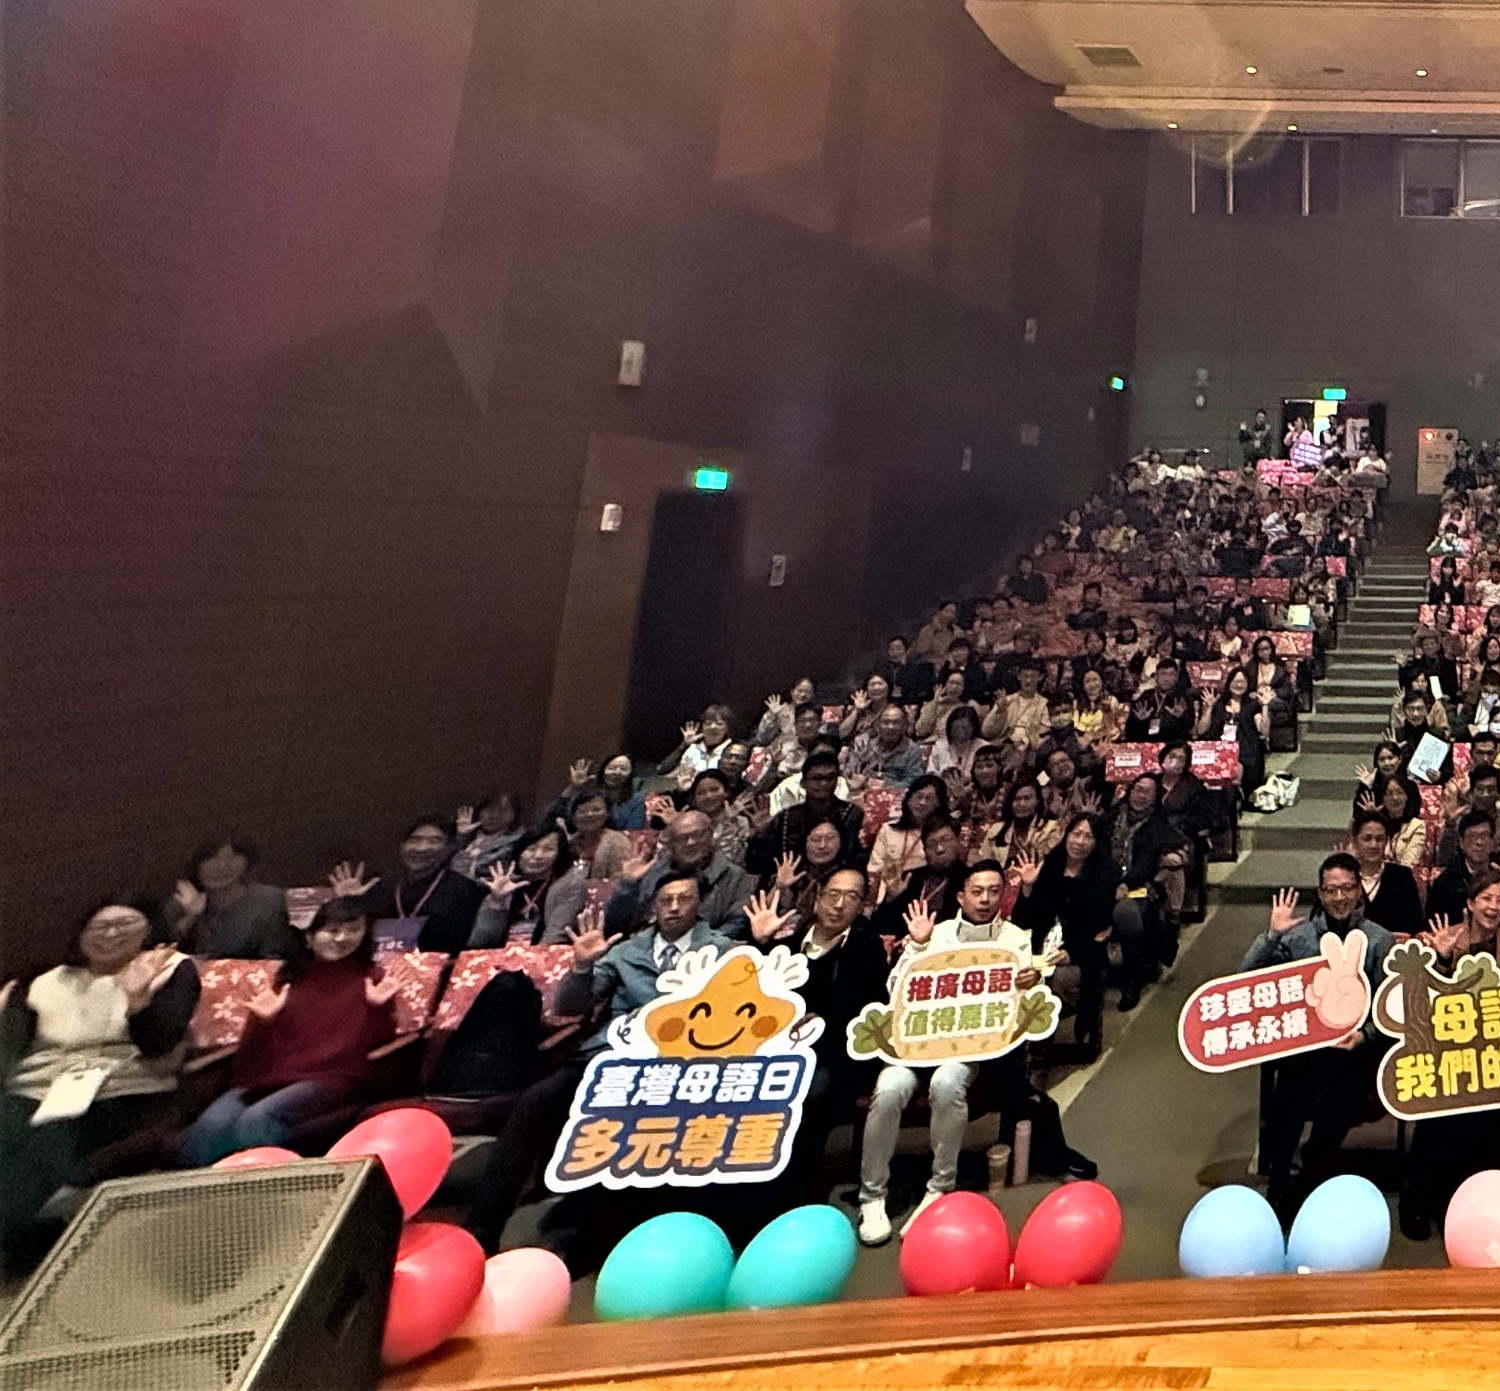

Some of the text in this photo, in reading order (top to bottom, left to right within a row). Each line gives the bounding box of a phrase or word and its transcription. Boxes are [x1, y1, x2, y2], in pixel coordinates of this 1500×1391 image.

[907, 967, 1013, 1003] 推廣母語
[1199, 975, 1304, 1022] 珍愛母語
[904, 1001, 1010, 1036] 值得嘉許
[1202, 1008, 1308, 1059] 傳承永續
[591, 1061, 801, 1108] 臺灣母語日
[563, 1114, 785, 1176] 多元尊重
